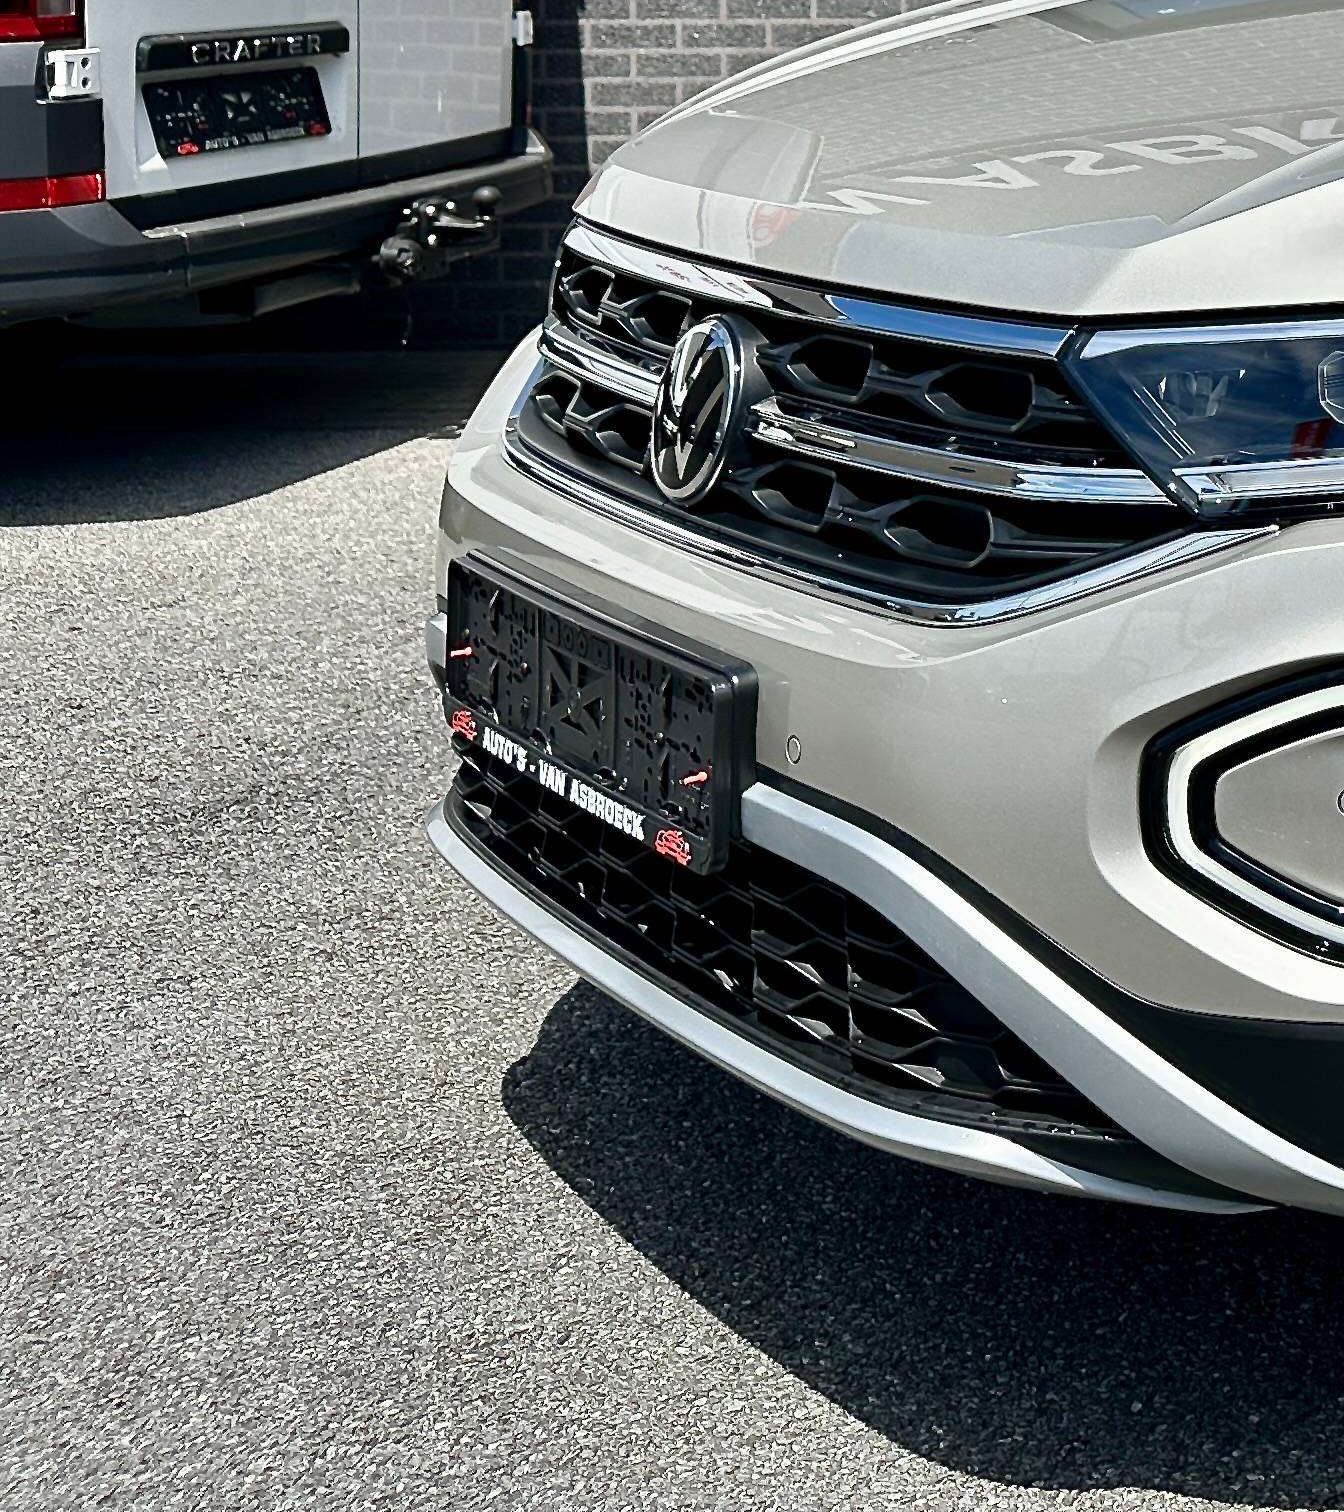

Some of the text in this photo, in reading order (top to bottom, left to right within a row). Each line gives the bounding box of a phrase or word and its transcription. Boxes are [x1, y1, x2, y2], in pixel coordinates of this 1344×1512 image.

[192, 34, 321, 64] CRAFTER
[482, 726, 528, 773] AUTO'S
[538, 758, 568, 797] VAN
[569, 778, 647, 842] ASBROECK
